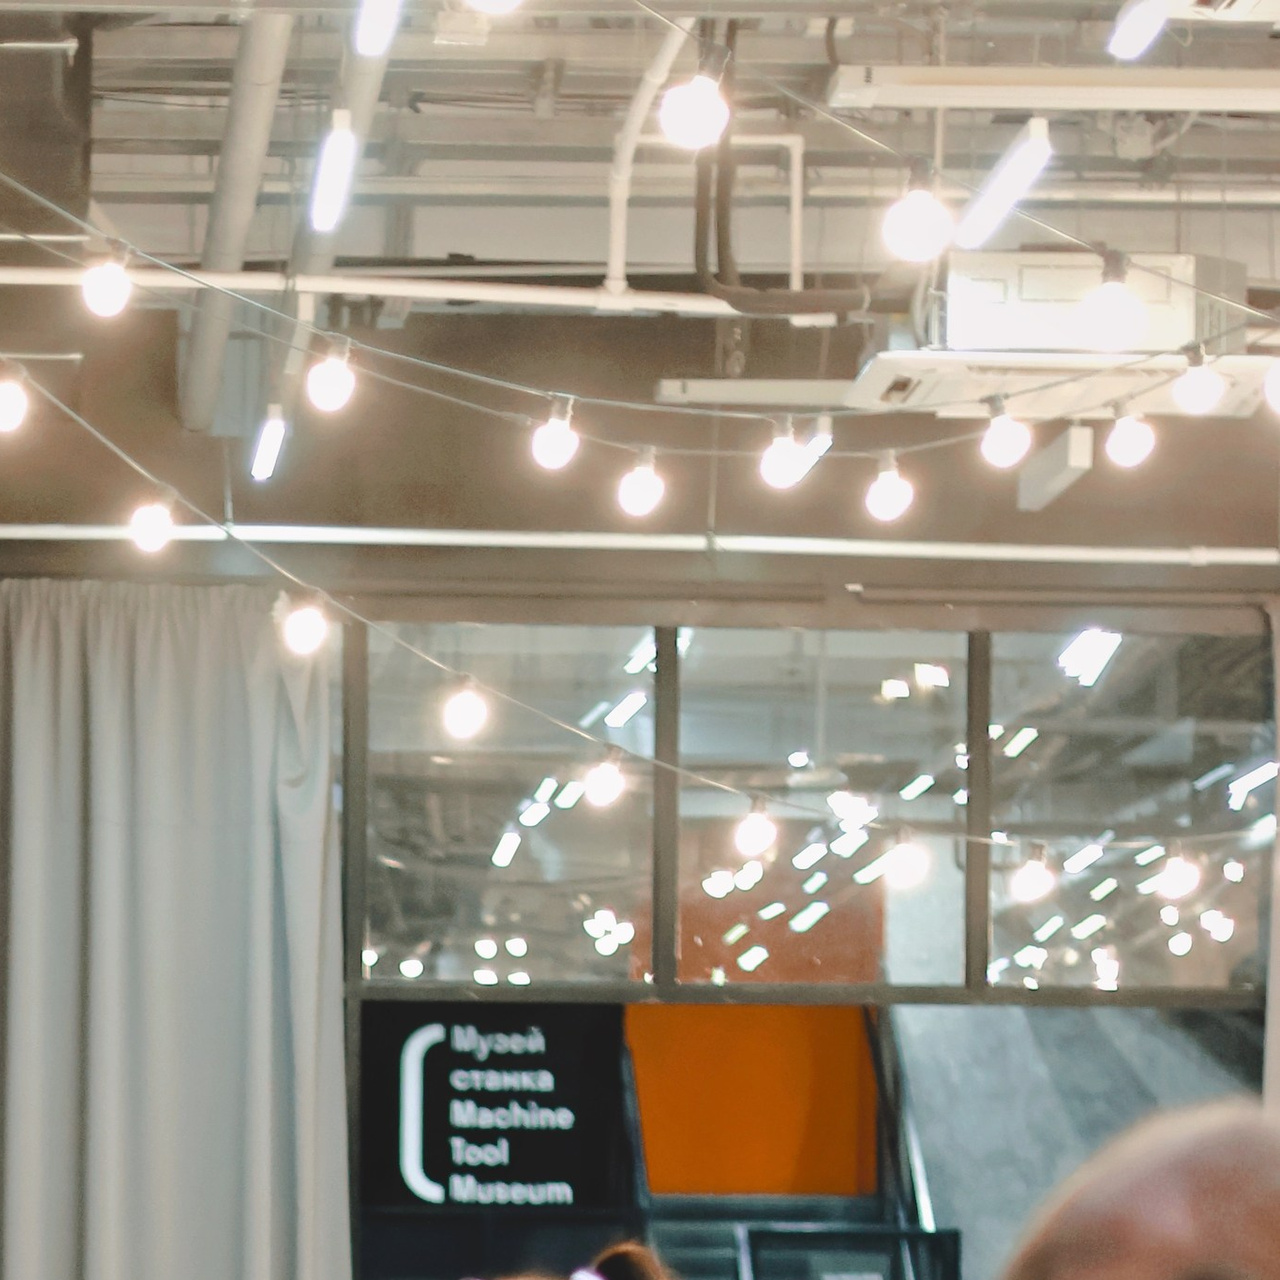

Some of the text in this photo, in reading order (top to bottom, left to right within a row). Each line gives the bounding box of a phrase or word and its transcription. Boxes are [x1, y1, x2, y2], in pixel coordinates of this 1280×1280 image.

[450, 1024, 546, 1062] Музей
[449, 1069, 555, 1092] станка
[449, 1099, 575, 1130] Machine
[449, 1136, 509, 1166] Tool
[449, 1173, 573, 1205] Museum
